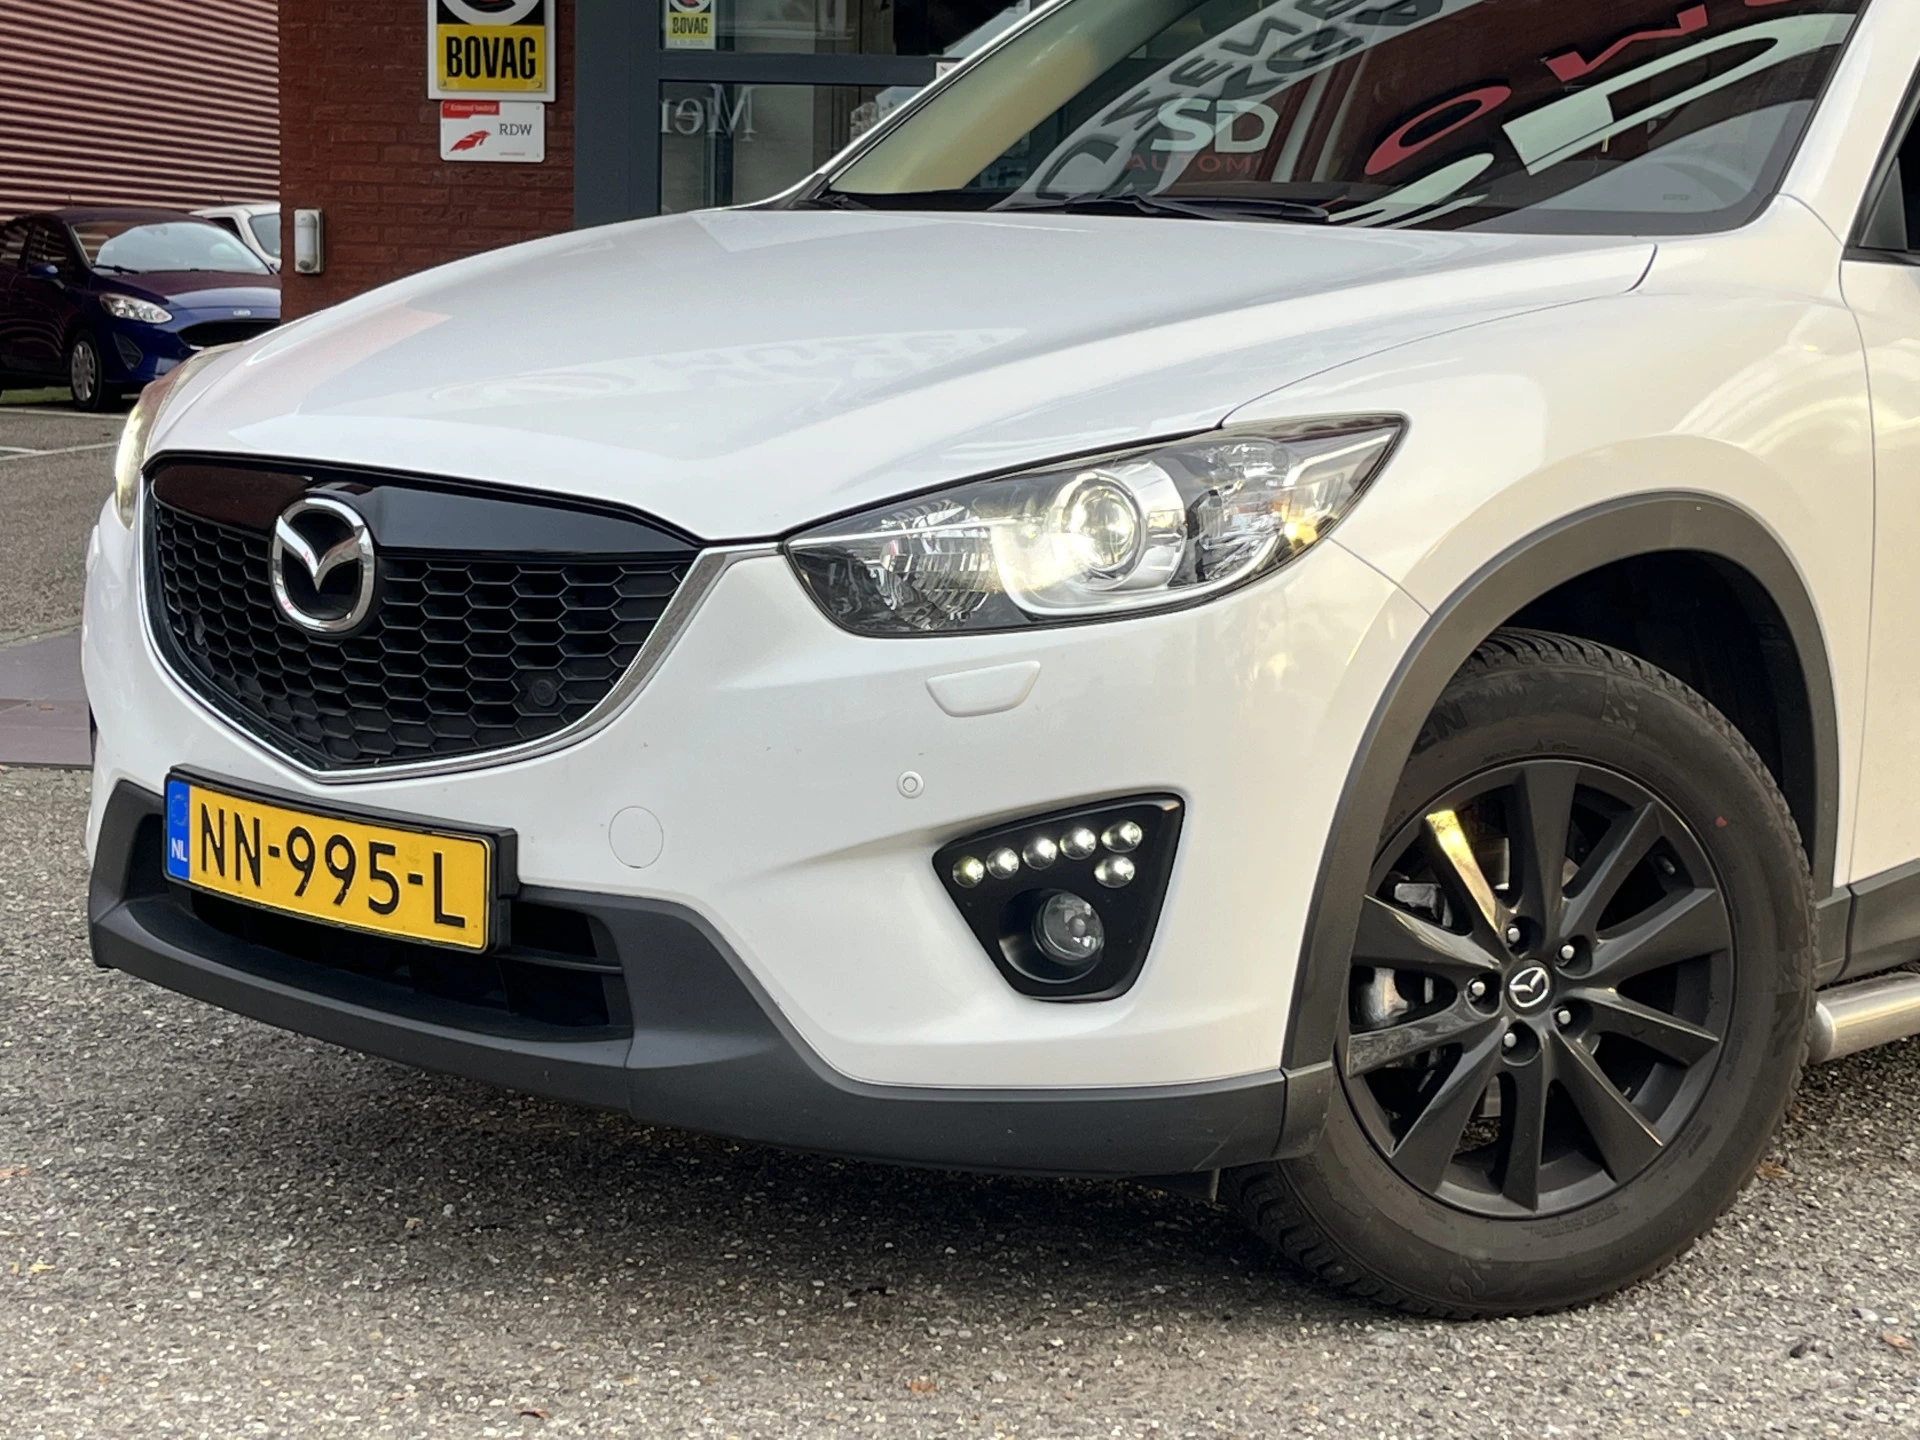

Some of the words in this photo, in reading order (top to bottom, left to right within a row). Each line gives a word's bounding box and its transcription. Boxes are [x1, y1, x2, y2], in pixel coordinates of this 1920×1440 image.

[672, 17, 708, 34] BOVAG
[446, 36, 536, 79] BOVAG
[499, 123, 532, 136] RDW
[1151, 98, 1279, 153] SD
[171, 838, 188, 862] NL
[201, 803, 465, 928] NN-995-L
